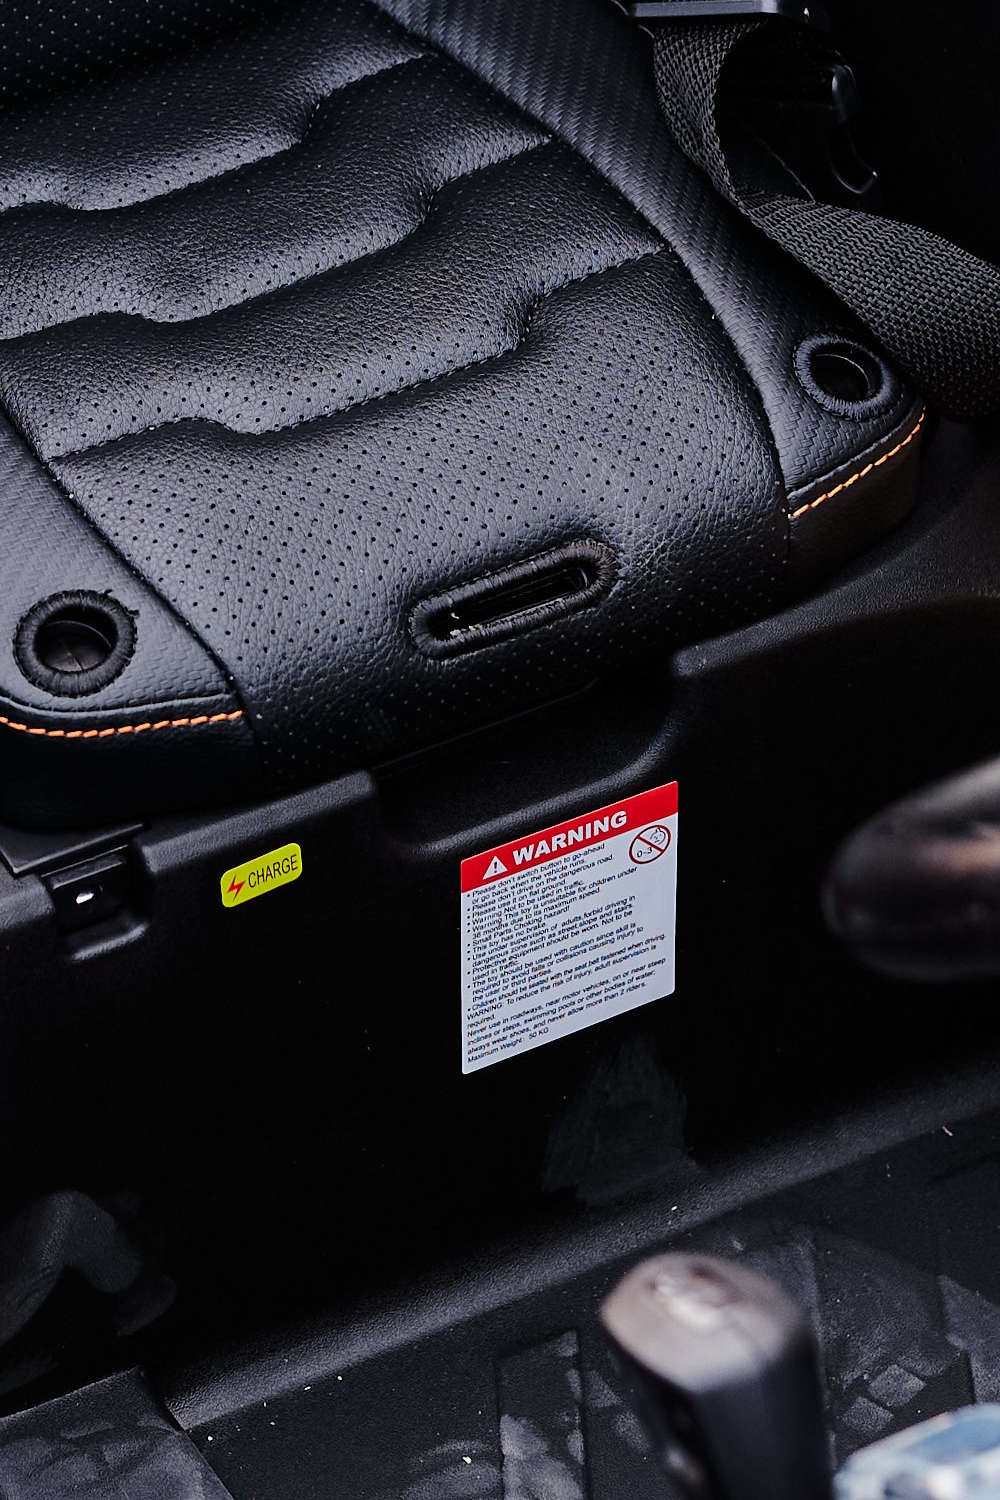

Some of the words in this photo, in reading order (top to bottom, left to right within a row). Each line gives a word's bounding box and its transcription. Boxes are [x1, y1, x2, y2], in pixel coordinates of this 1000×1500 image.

[513, 810, 627, 866] WARNING
[248, 854, 298, 888] CHARGE
[472, 884, 496, 897] Please
[497, 876, 515, 888] don't
[516, 868, 538, 881] switch
[539, 858, 562, 872] button
[571, 842, 604, 861] go-ahead
[472, 898, 496, 911] Please
[497, 890, 515, 902] don't
[515, 883, 534, 895] drive
[558, 861, 595, 879] dangerous
[491, 886, 508, 897] back
[509, 878, 529, 890] when
[543, 864, 568, 878] vehicle
[540, 889, 576, 907] unsuitable
[588, 874, 616, 889] children
[616, 867, 637, 878] under
[472, 905, 496, 918] Please
[528, 888, 539, 897] flat
[482, 921, 508, 935] months
[542, 894, 577, 913] maximum
[536, 889, 554, 901] used
[472, 934, 492, 946] Small
[487, 942, 509, 954] under
[509, 927, 549, 946] supervision
[604, 898, 627, 911] driving
[472, 943, 487, 954] This
[472, 949, 509, 969] dangerous
[510, 942, 527, 953] zone
[528, 934, 546, 946] such
[472, 956, 507, 975] Protective
[507, 942, 544, 962] equipment
[546, 932, 569, 946] should
[499, 963, 523, 978] should
[534, 952, 552, 965] used
[553, 948, 568, 957] with
[568, 938, 594, 951] caution
[595, 930, 614, 941] since
[615, 923, 628, 934] skill
[510, 968, 530, 981] avoid
[530, 963, 545, 973] falls
[555, 947, 587, 963] collisions
[588, 937, 615, 951] causing
[616, 928, 635, 940] injury
[471, 997, 497, 1010] Children
[497, 988, 518, 1001] should
[528, 976, 549, 989] seated
[549, 972, 562, 980] with
[600, 946, 626, 961] fastened
[626, 941, 643, 951] when
[472, 970, 489, 981] used
[484, 987, 501, 997] user
[510, 976, 526, 987] third
[515, 989, 538, 1002] reduce
[552, 978, 564, 988] risk
[594, 960, 610, 971] adult
[611, 946, 649, 964] supervision
[467, 1025, 487, 1037] Never
[544, 997, 561, 1007] near
[561, 989, 581, 1001] motor
[630, 964, 646, 974] near
[647, 957, 665, 968] steep
[467, 1032, 492, 1046] inclines
[523, 1007, 556, 1024] swimming
[557, 999, 576, 1012] pools
[585, 989, 602, 1000] other
[603, 980, 626, 993] bodies
[467, 1041, 490, 1055] always
[491, 1035, 508, 1045] wear
[546, 1012, 566, 1024] never
[566, 1005, 584, 1016] allow
[585, 998, 602, 1008] more
[603, 992, 618, 1001] than
[467, 1047, 498, 1063] Maximum
